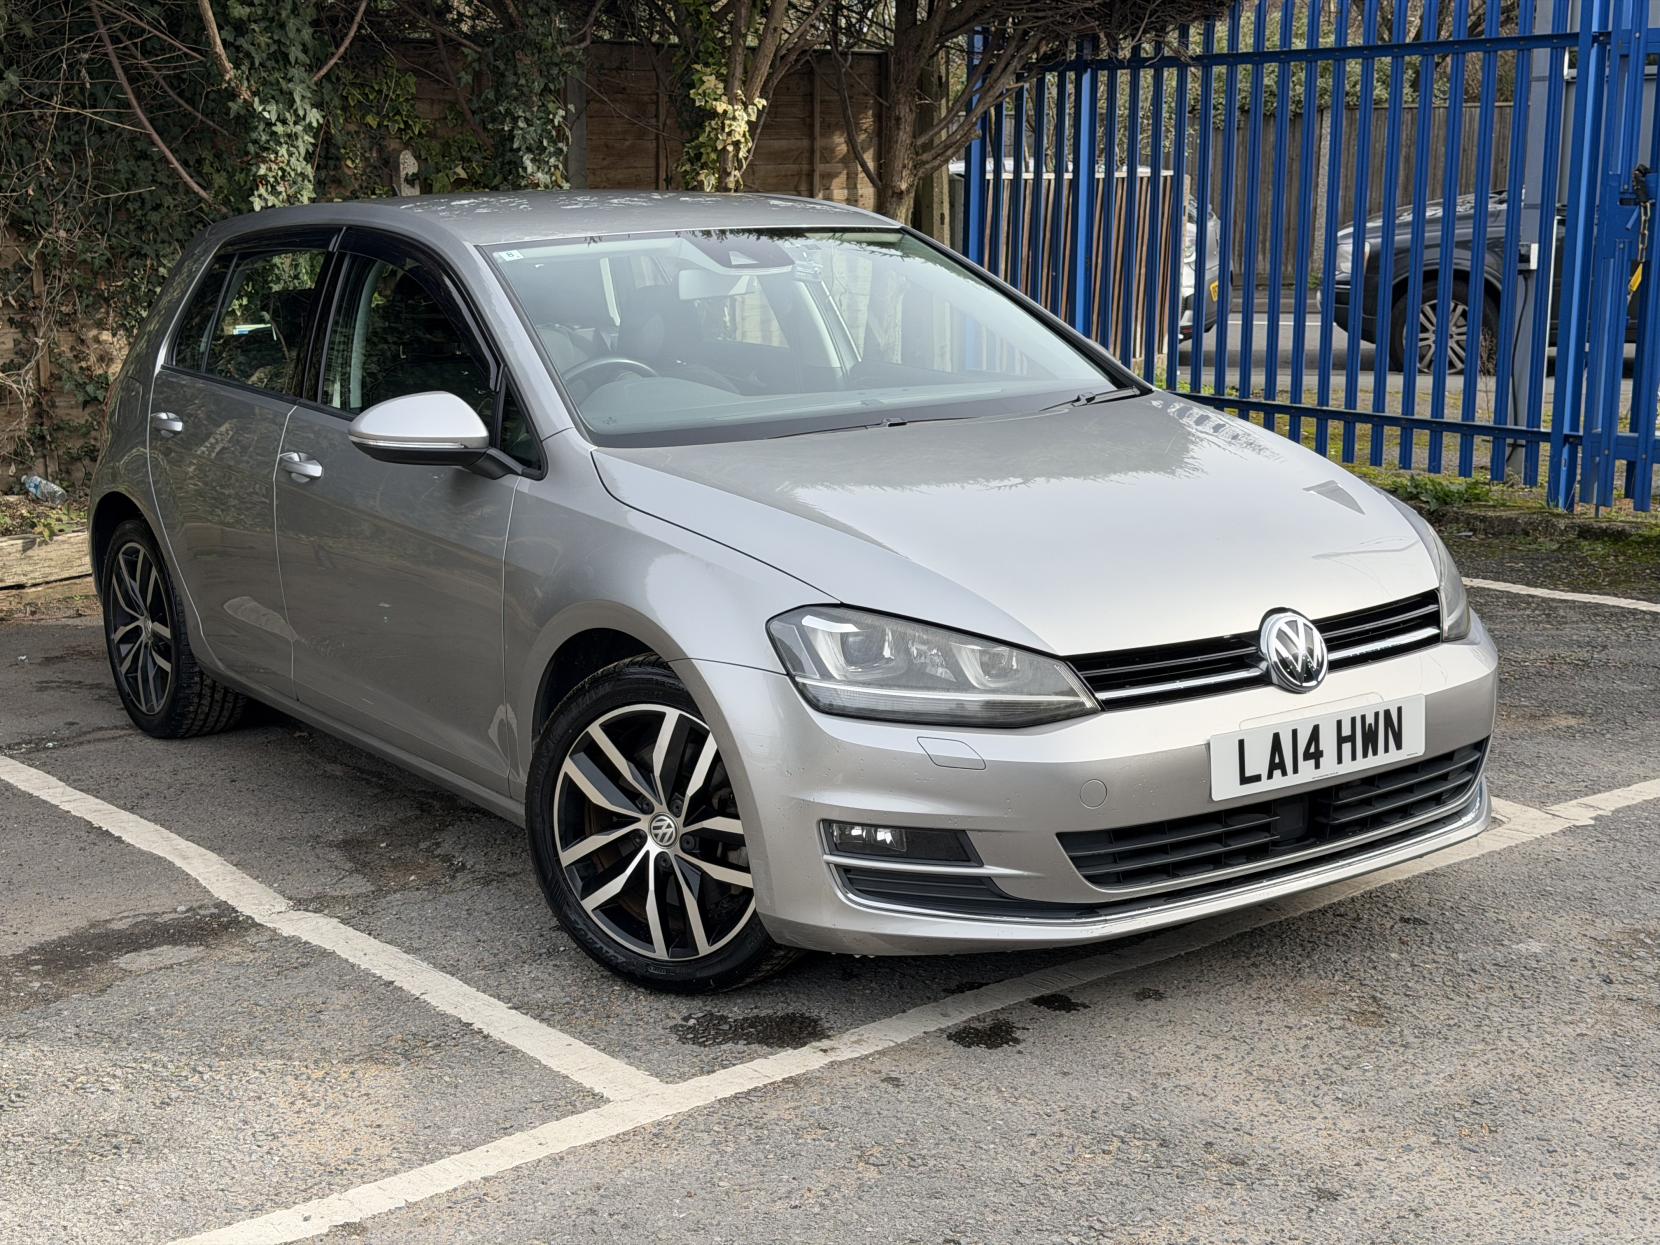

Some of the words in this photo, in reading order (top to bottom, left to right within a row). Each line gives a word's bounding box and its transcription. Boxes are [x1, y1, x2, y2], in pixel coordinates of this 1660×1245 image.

[1266, 612, 1328, 690] VW
[1238, 724, 1323, 786] LA14
[1336, 706, 1403, 765] HWN
